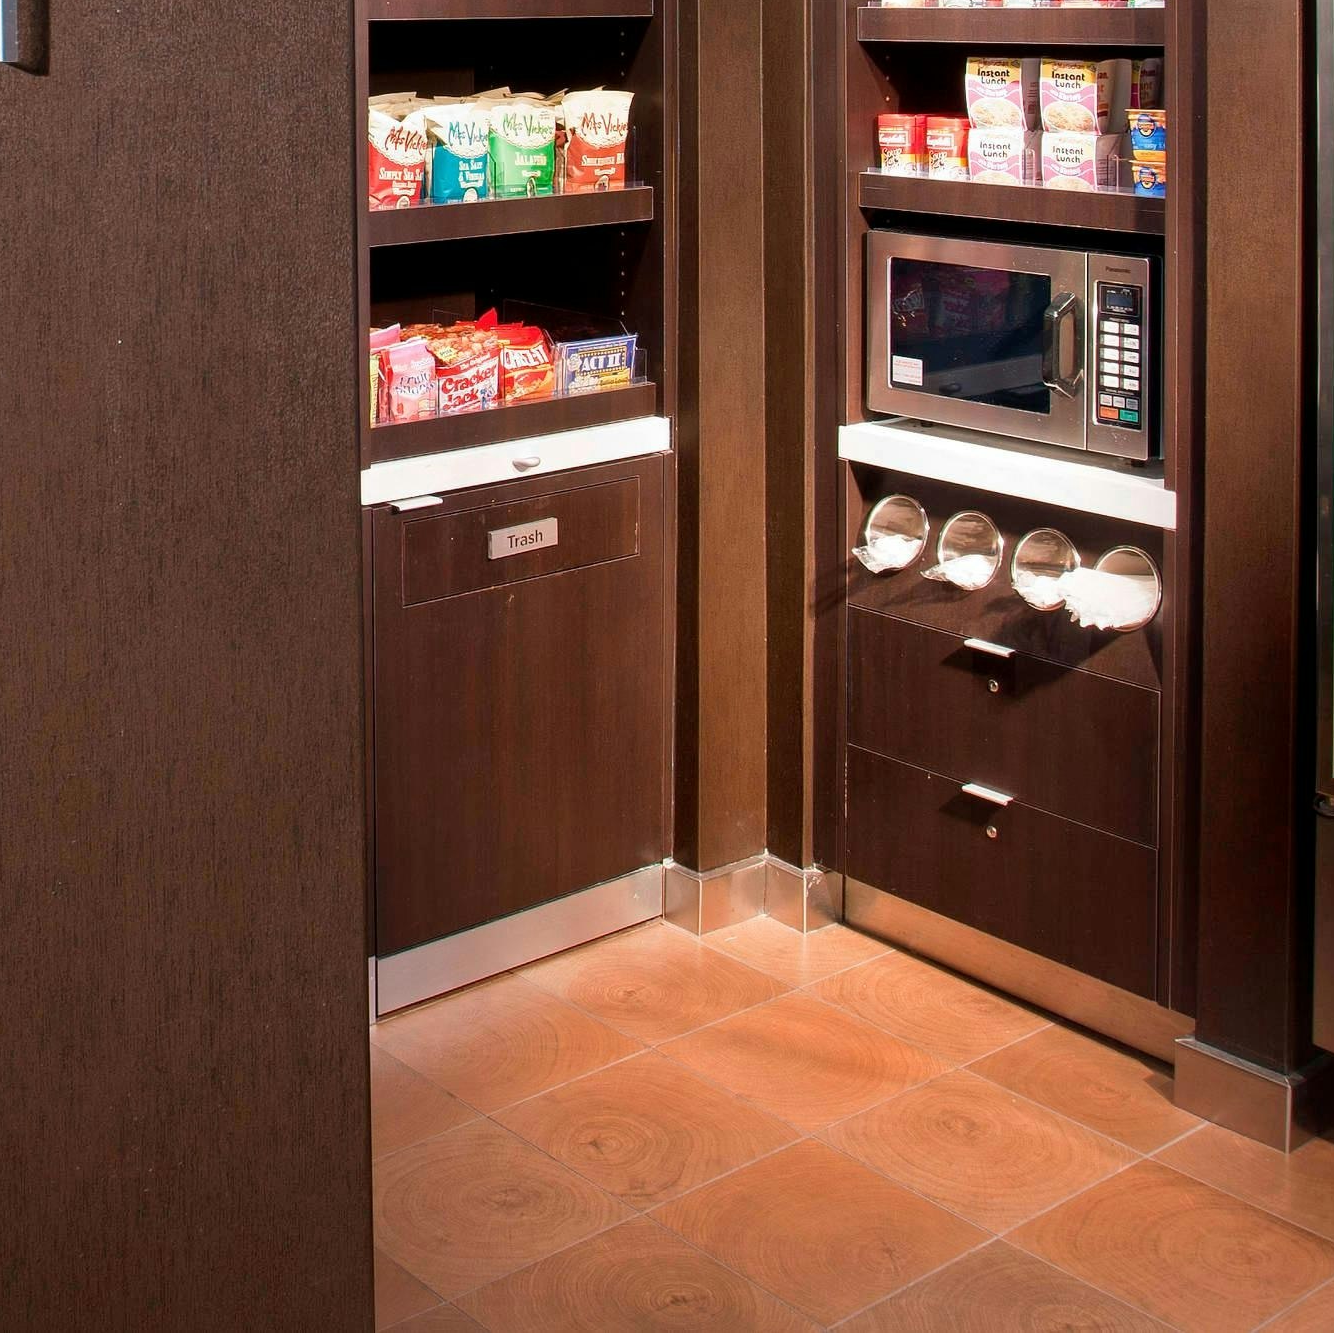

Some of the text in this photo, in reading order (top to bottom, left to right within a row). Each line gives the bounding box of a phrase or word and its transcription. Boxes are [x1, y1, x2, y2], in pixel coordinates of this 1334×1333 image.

[977, 68, 1011, 78] Instant
[1051, 70, 1086, 82] Instant
[981, 77, 1007, 86] Lunch
[1055, 79, 1082, 90] Lunch
[979, 140, 1012, 151] Instant
[1052, 145, 1084, 156] Instant
[983, 149, 1009, 159] Lunch
[1056, 155, 1082, 164] Lunch
[581, 355, 605, 372] ACT
[441, 364, 498, 394] Cracker
[507, 530, 543, 549] Trash
